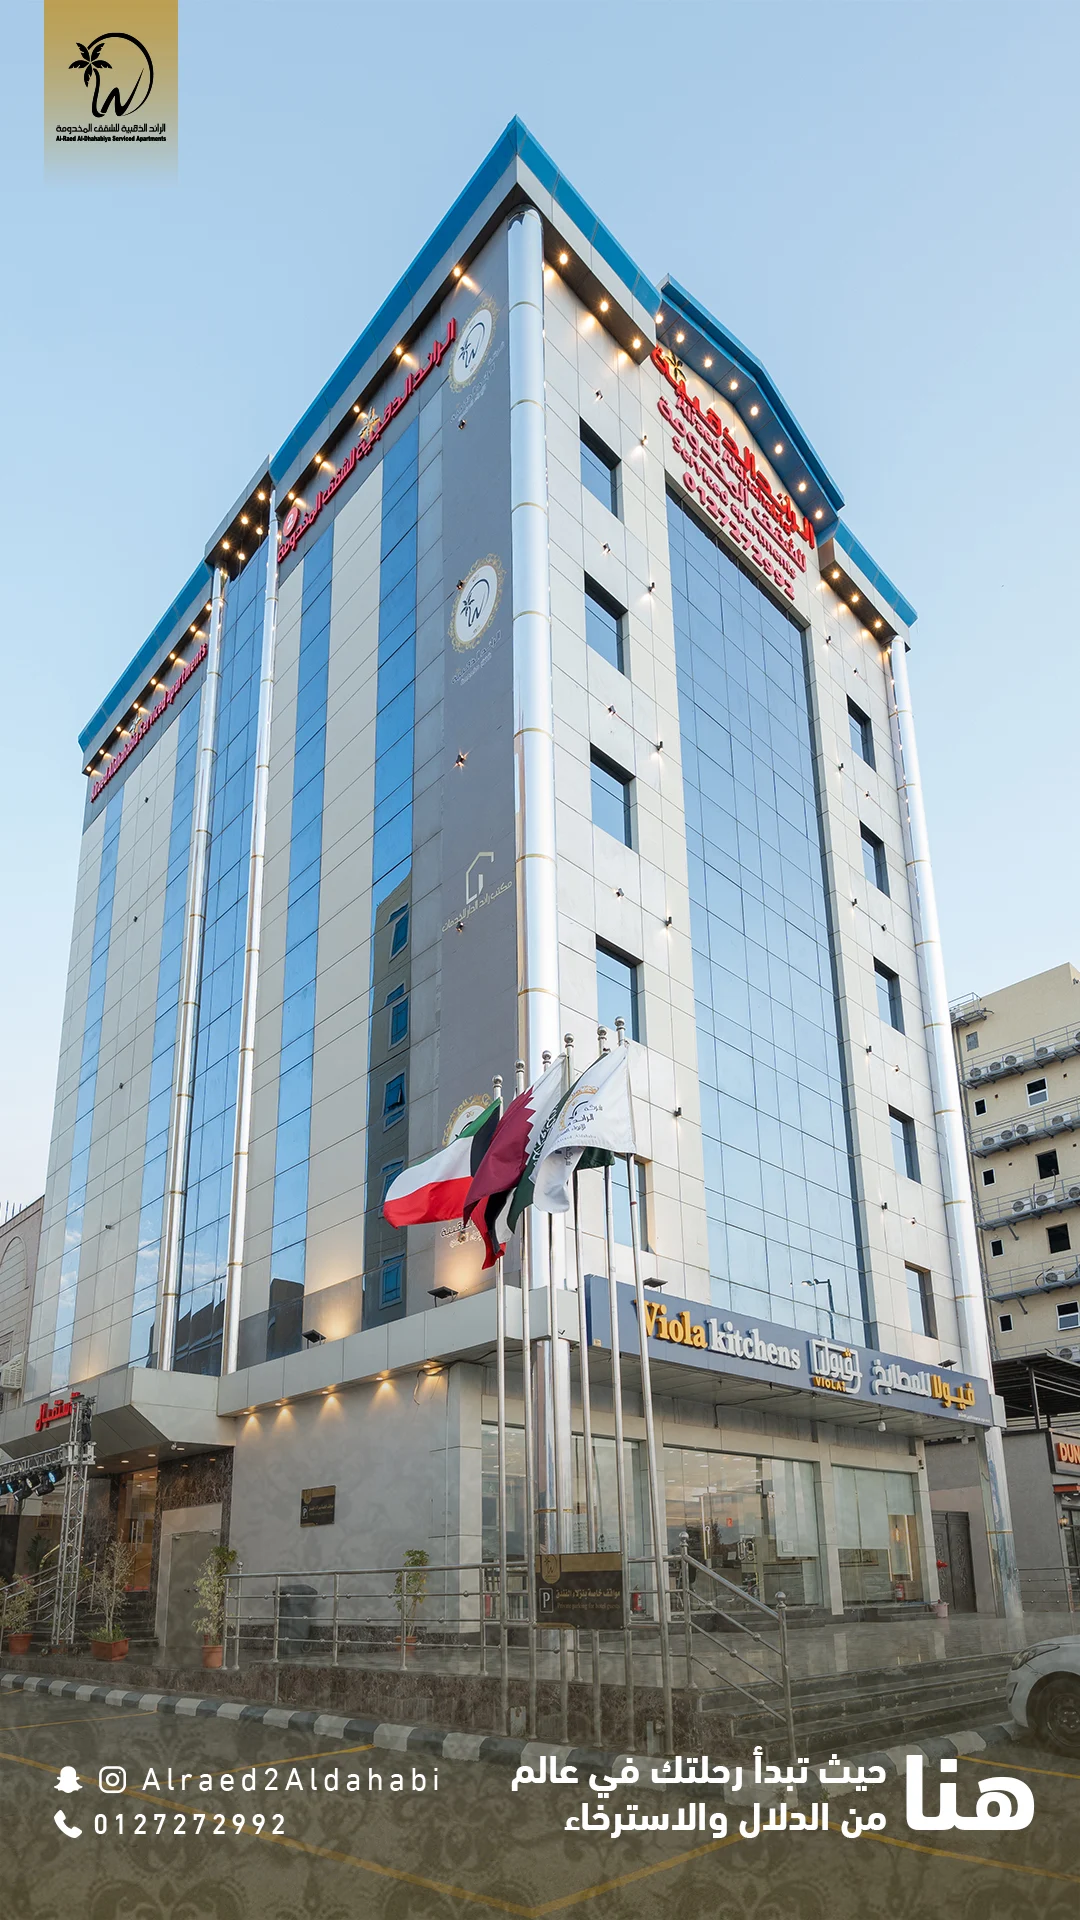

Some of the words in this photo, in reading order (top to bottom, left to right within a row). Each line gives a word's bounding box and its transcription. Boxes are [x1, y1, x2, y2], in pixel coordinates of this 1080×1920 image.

[671, 435, 729, 507] Serviced
[730, 502, 798, 580] apartments
[682, 471, 796, 601] 0127272992
[634, 1299, 709, 1349] Viola
[706, 1317, 801, 1371] kitchens
[868, 1358, 932, 1396] للمطابخ
[930, 1373, 976, 1410] فيولا
